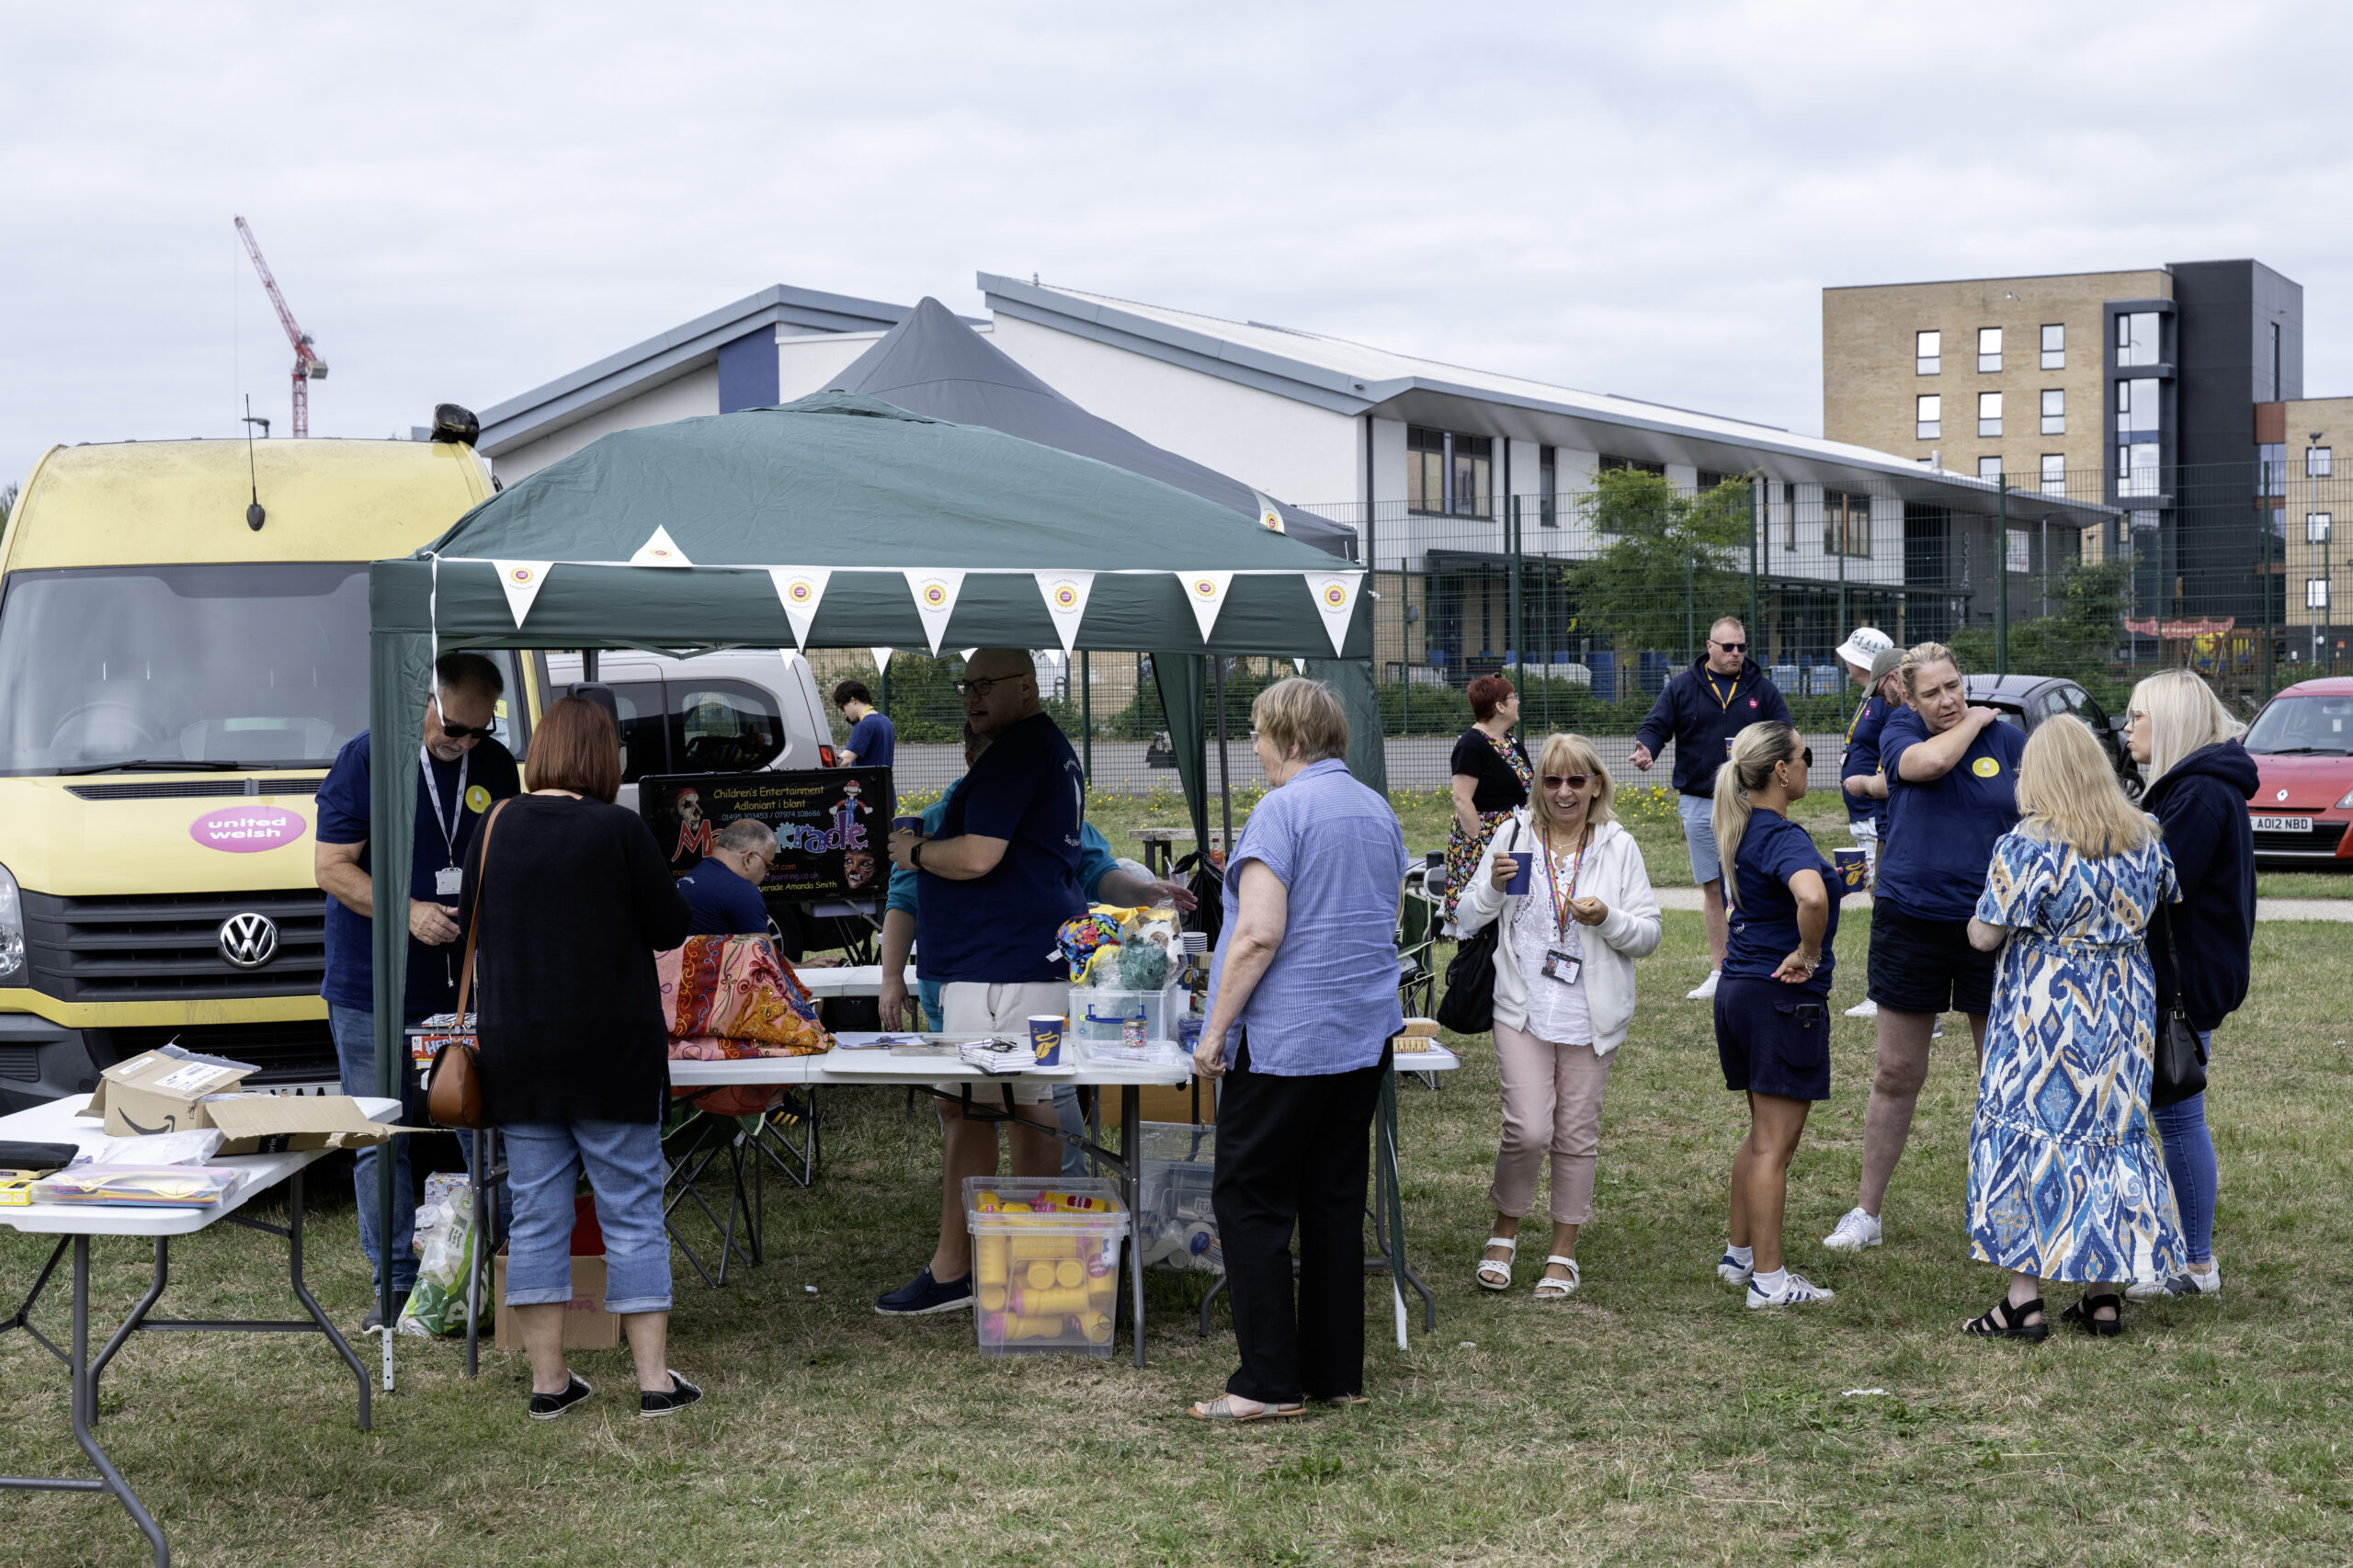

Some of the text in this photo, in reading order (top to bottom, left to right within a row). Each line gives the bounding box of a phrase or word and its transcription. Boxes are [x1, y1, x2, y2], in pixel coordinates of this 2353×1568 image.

[713, 785, 824, 799] Children's Entertainment
[734, 801, 776, 810] Adloniant
[783, 799, 806, 809] blant
[775, 811, 796, 819] 07974
[208, 817, 287, 829] united
[2285, 819, 2308, 830] NBD
[210, 828, 281, 840] welsh
[785, 882, 813, 891] Amanda
[815, 880, 837, 889] Smith
